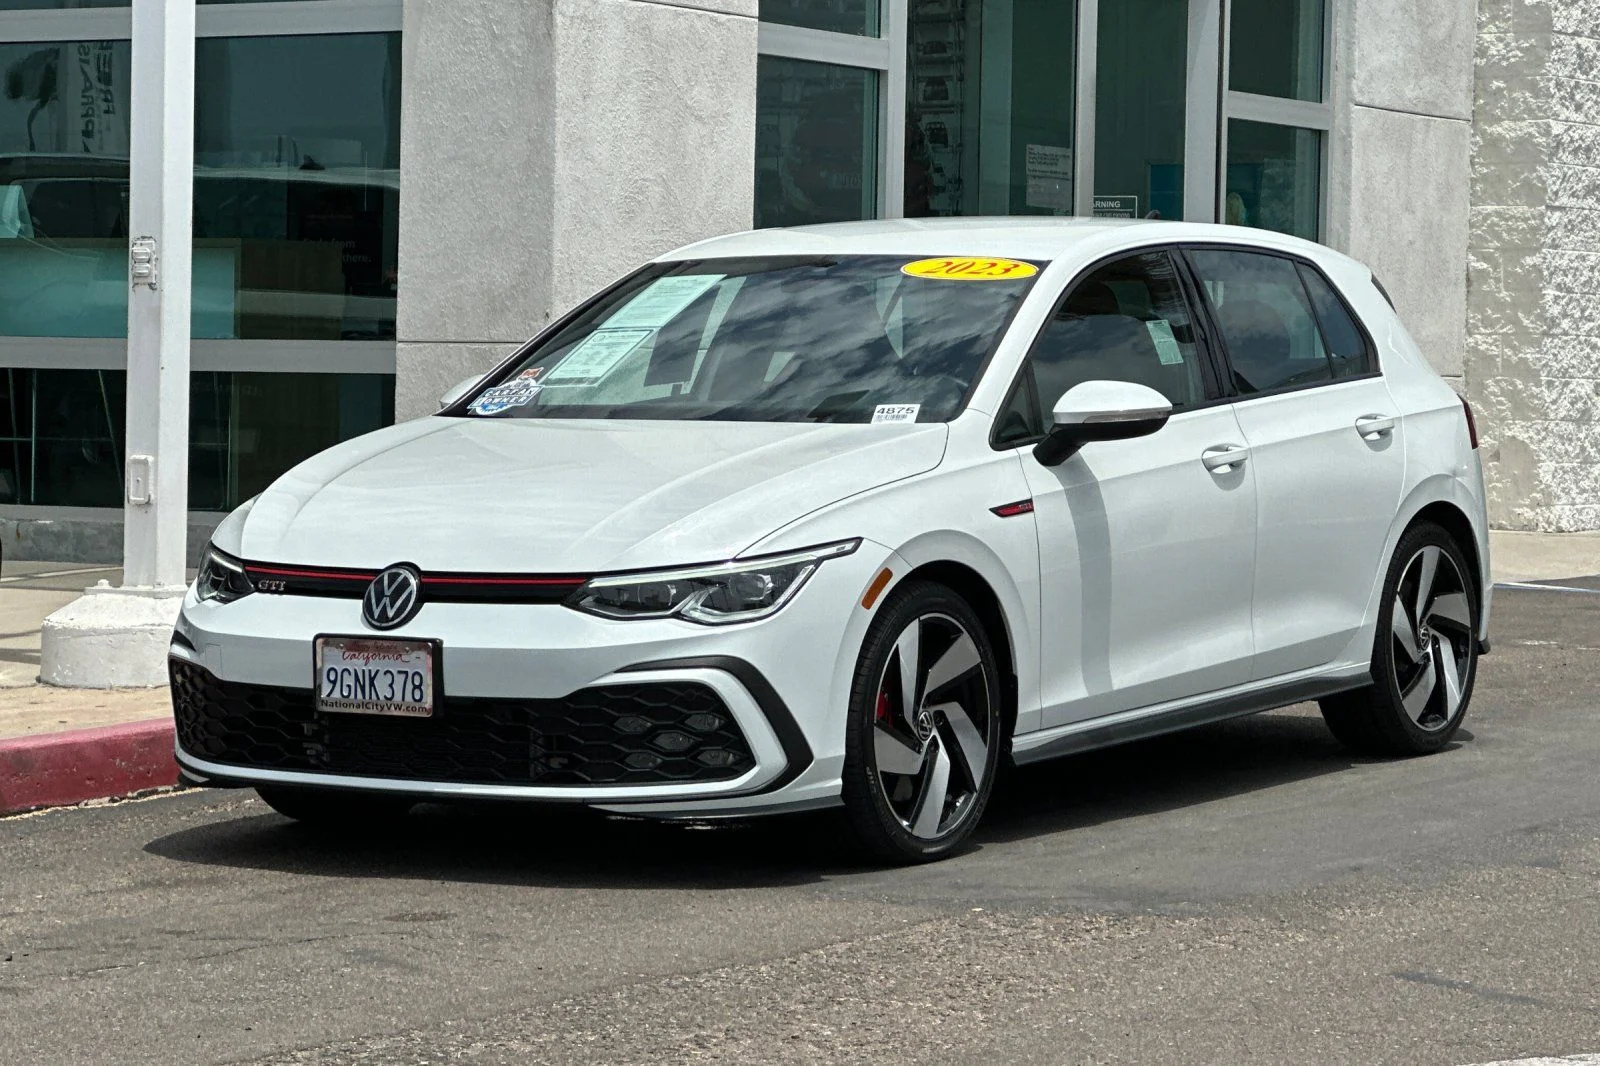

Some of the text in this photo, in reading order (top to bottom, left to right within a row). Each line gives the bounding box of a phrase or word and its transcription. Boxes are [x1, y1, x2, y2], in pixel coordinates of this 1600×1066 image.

[920, 261, 1020, 276] 2023
[877, 406, 916, 415] 4875
[258, 580, 286, 591] GTI
[342, 651, 410, 666] California
[325, 666, 424, 704] 9GNK378
[320, 699, 428, 714] NationalCityVW.com
